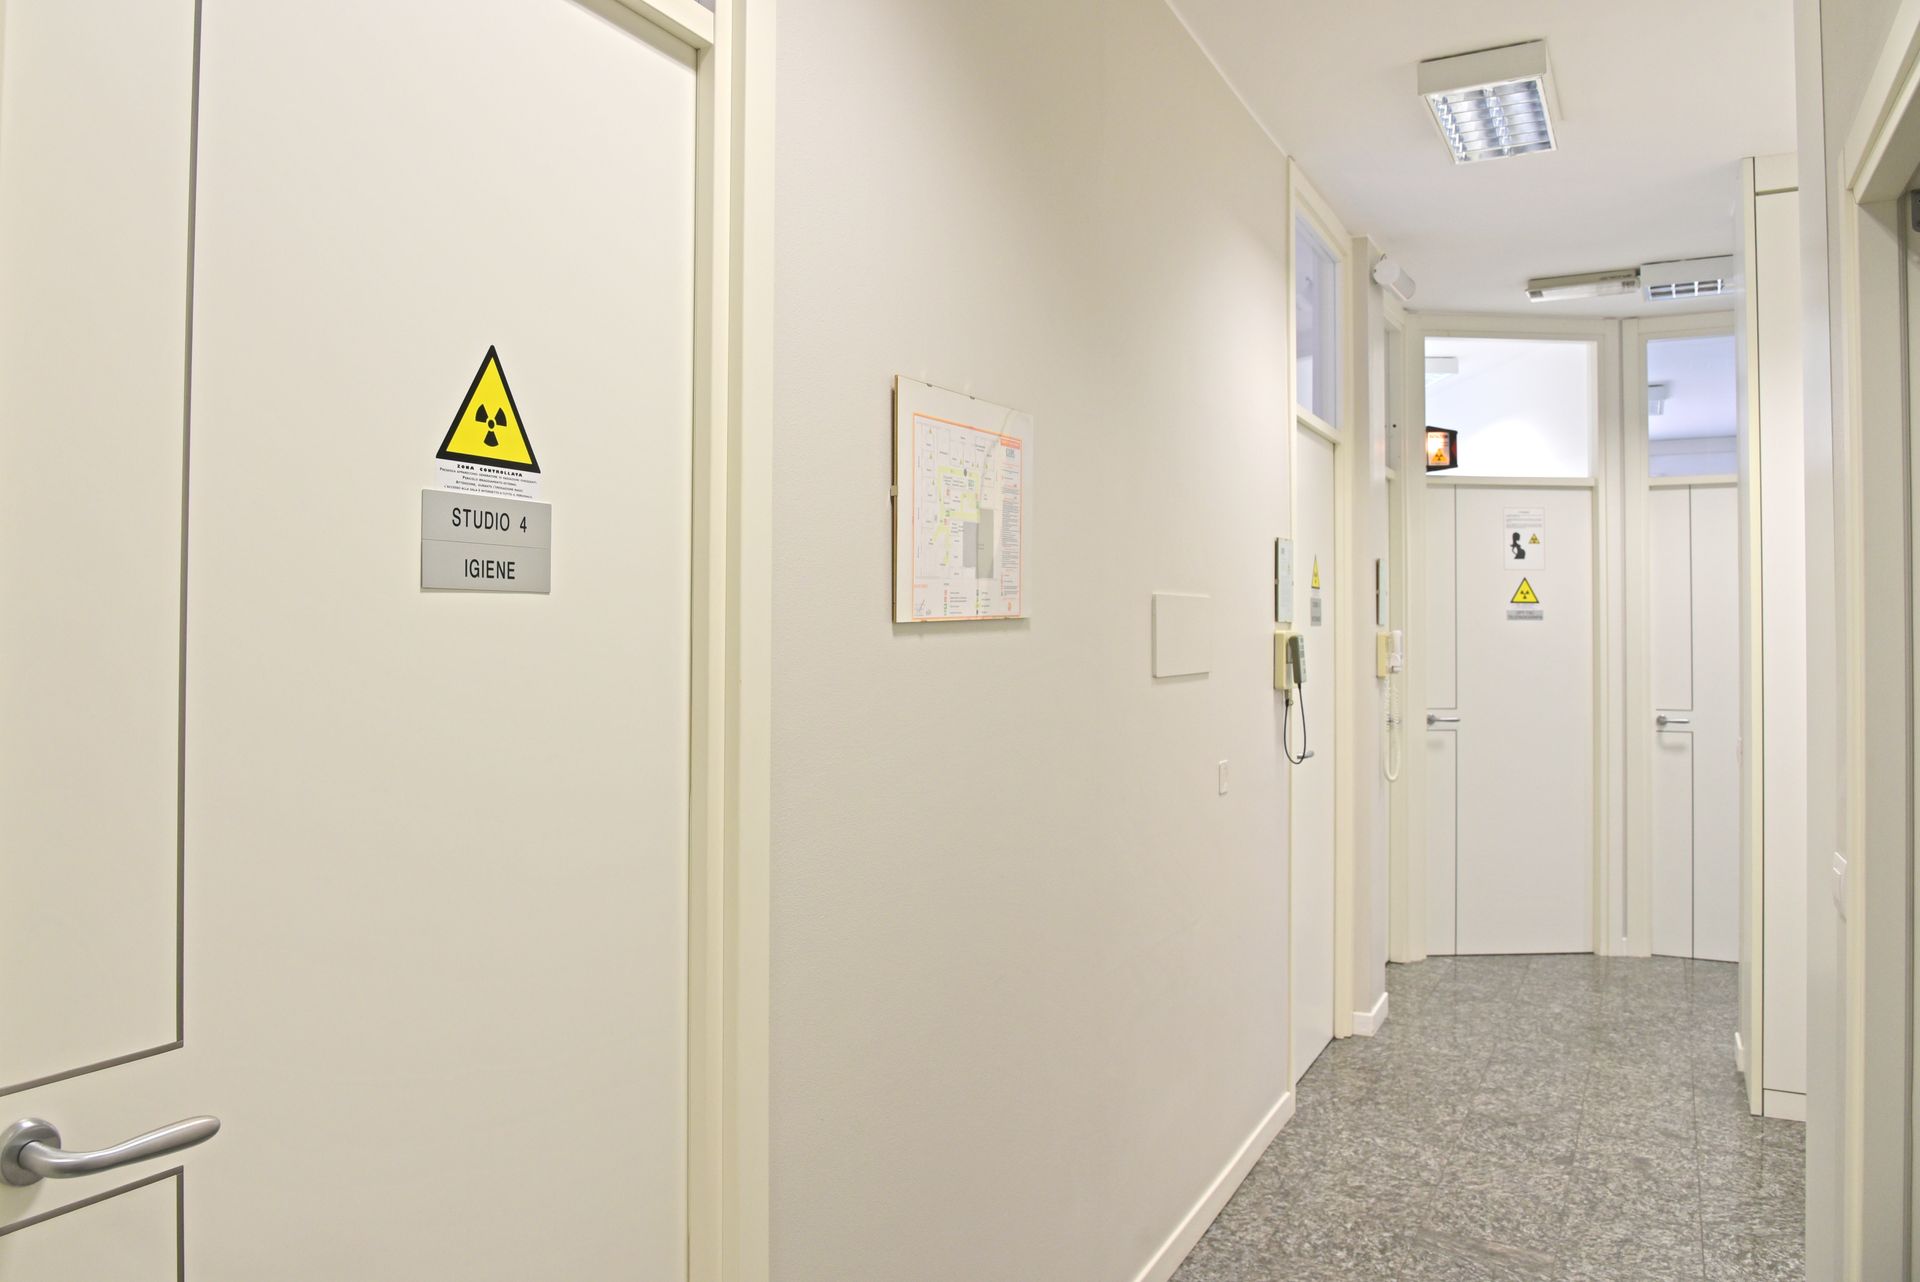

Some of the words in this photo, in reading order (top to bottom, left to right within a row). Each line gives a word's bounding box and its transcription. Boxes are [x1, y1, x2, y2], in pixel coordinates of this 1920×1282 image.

[457, 463, 475, 471] ZONA
[479, 467, 523, 477] CONTROLLATA
[452, 507, 510, 531] STUDIO
[519, 516, 527, 533] 4
[464, 559, 515, 580] IGIENE
